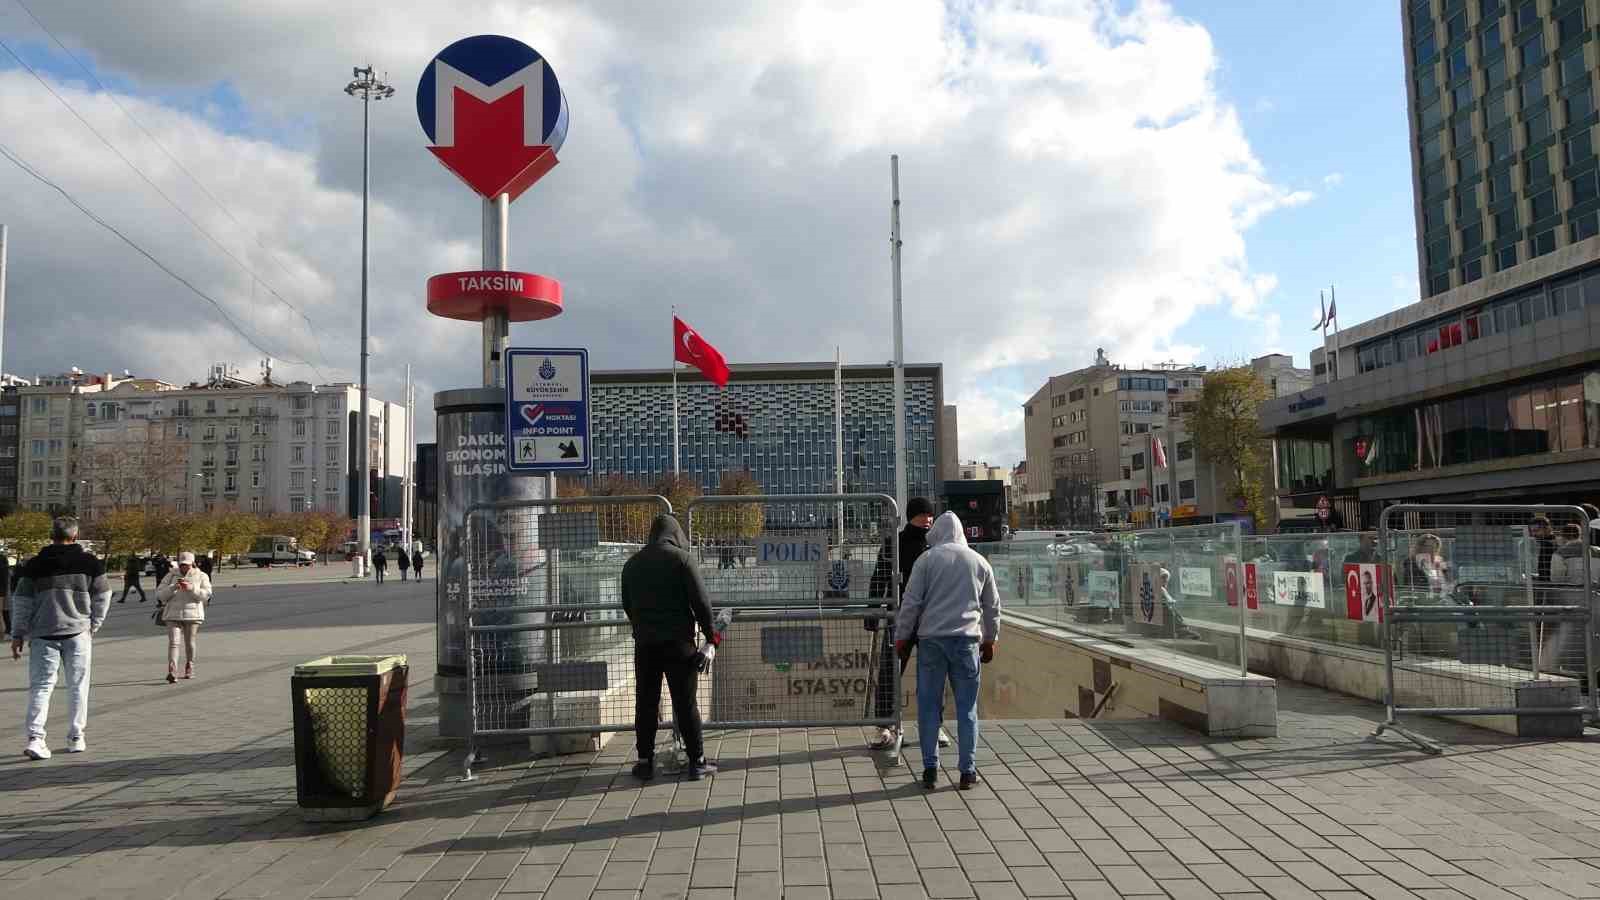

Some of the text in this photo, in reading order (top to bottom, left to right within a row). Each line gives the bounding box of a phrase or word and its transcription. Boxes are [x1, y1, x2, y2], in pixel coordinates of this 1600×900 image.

[458, 274, 524, 292] TAKSİM
[522, 427, 575, 435] INFO POINT
[763, 540, 821, 560] POLİS
